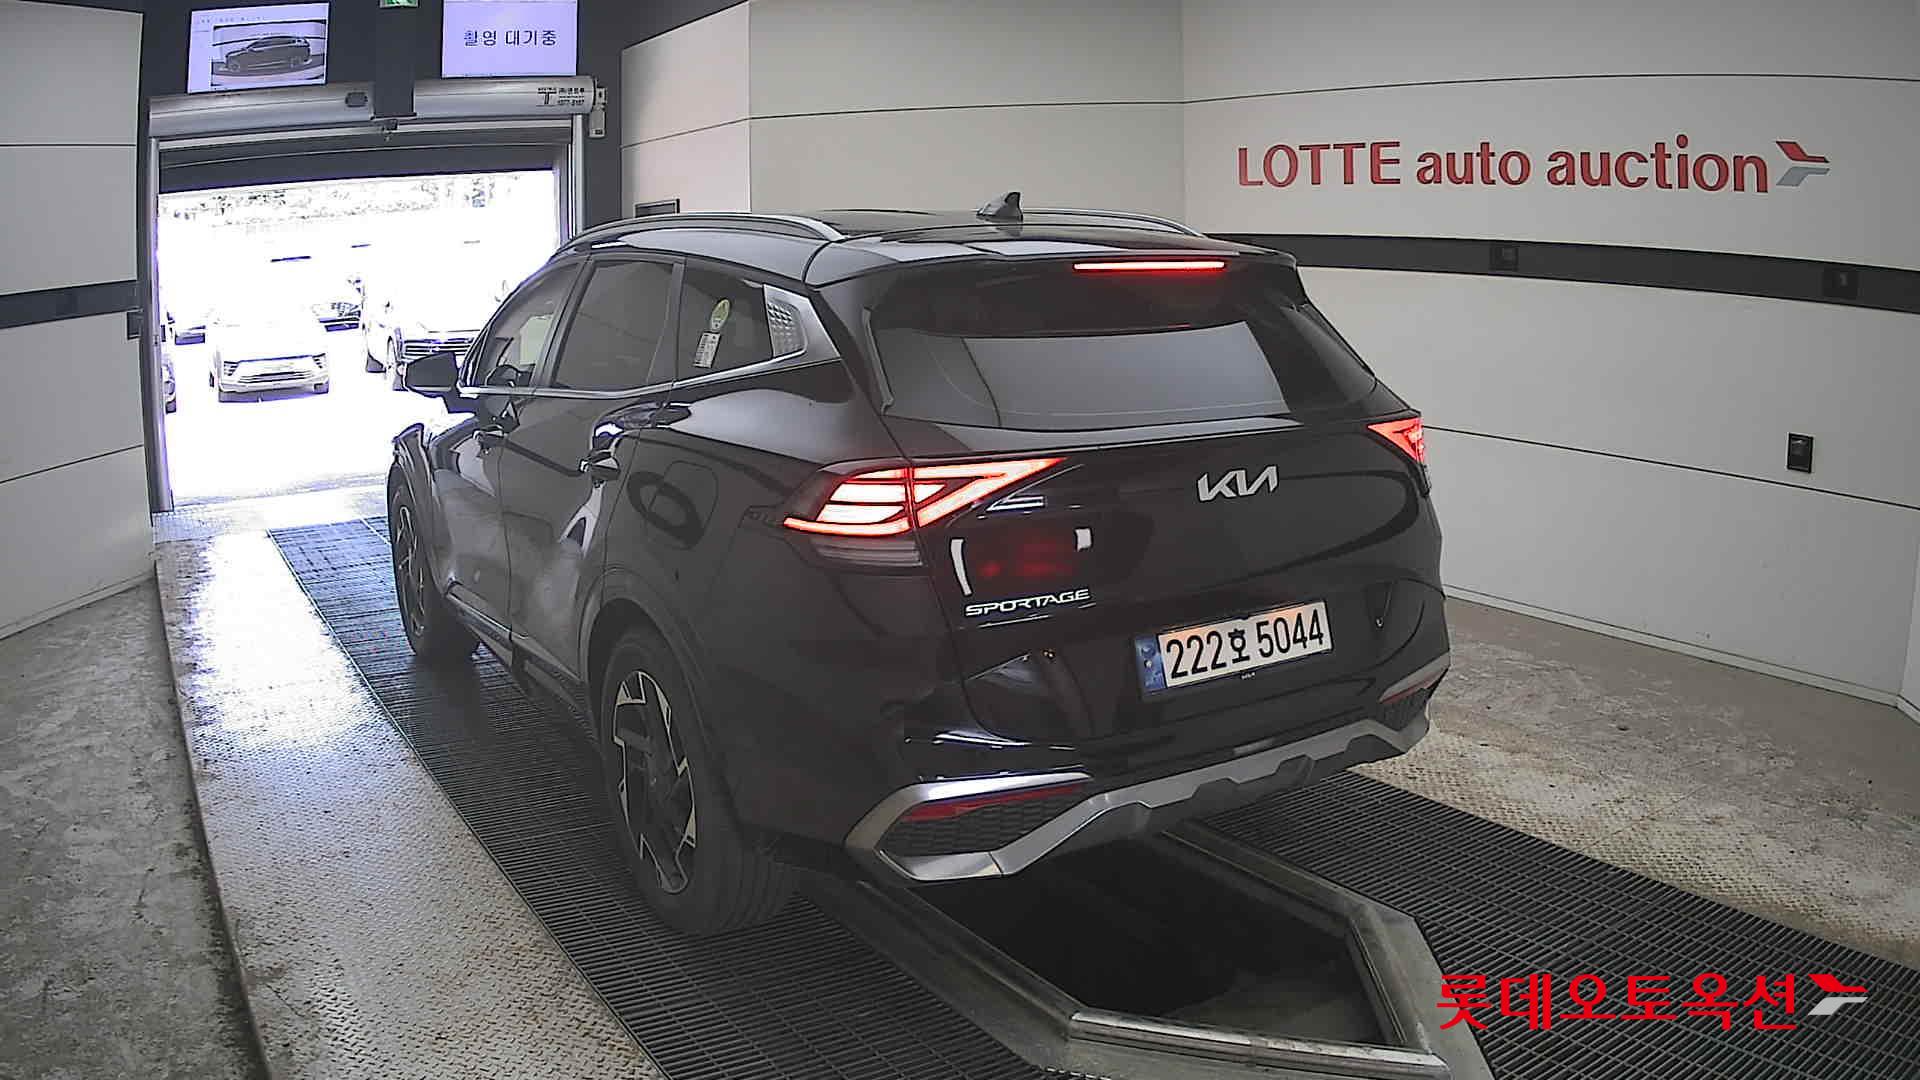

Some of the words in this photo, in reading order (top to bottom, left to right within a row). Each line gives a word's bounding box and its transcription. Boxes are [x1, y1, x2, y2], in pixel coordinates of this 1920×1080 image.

[504, 29, 557, 46] 대기중
[1237, 141, 1401, 187] LOTTE
[1415, 142, 1531, 186] auto
[1547, 134, 1769, 193] auction
[1197, 465, 1278, 501] KIA
[965, 588, 1091, 617] SPORTAGE
[1165, 627, 1250, 679] 222호
[1256, 608, 1324, 659] 5044
